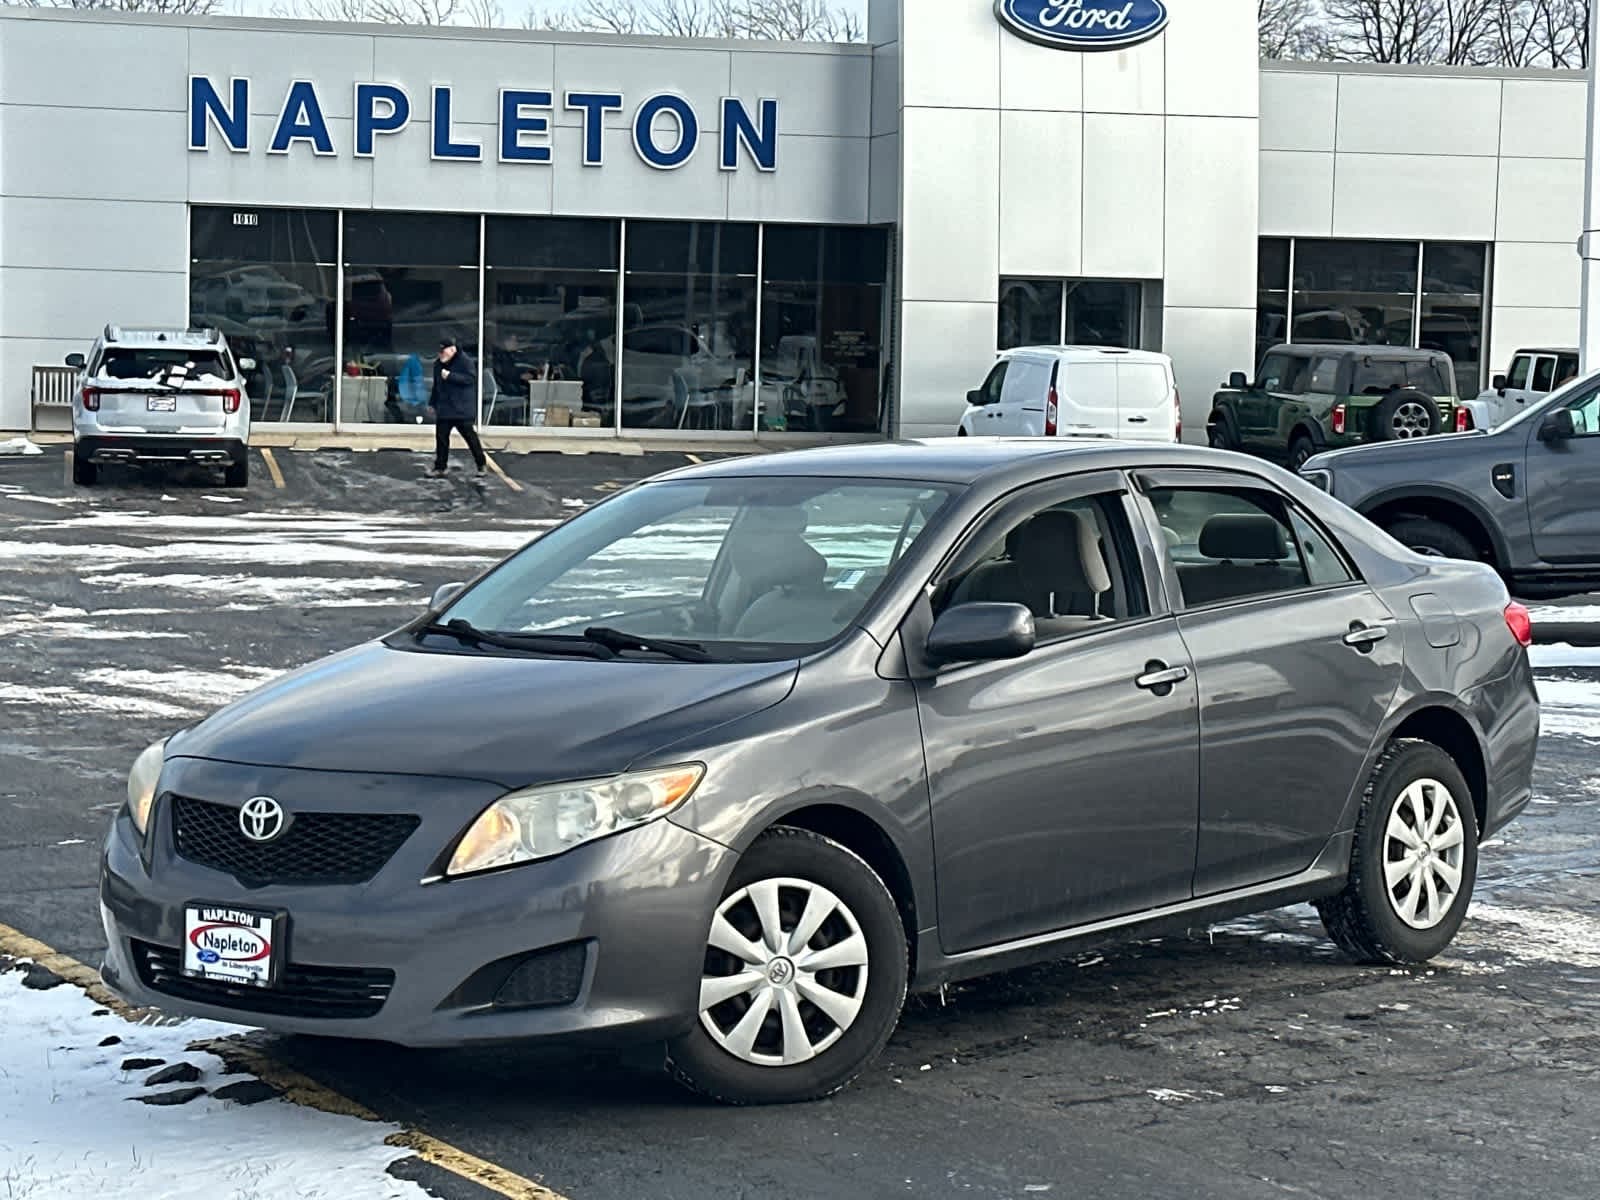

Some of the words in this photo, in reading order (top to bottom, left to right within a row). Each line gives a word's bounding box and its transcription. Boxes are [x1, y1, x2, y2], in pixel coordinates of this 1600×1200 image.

[1039, 0, 1134, 30] Ford
[188, 74, 778, 172] NAPLETON
[233, 213, 258, 225] 1010
[203, 909, 254, 927] NAPLETON
[204, 931, 258, 954] Napleton
